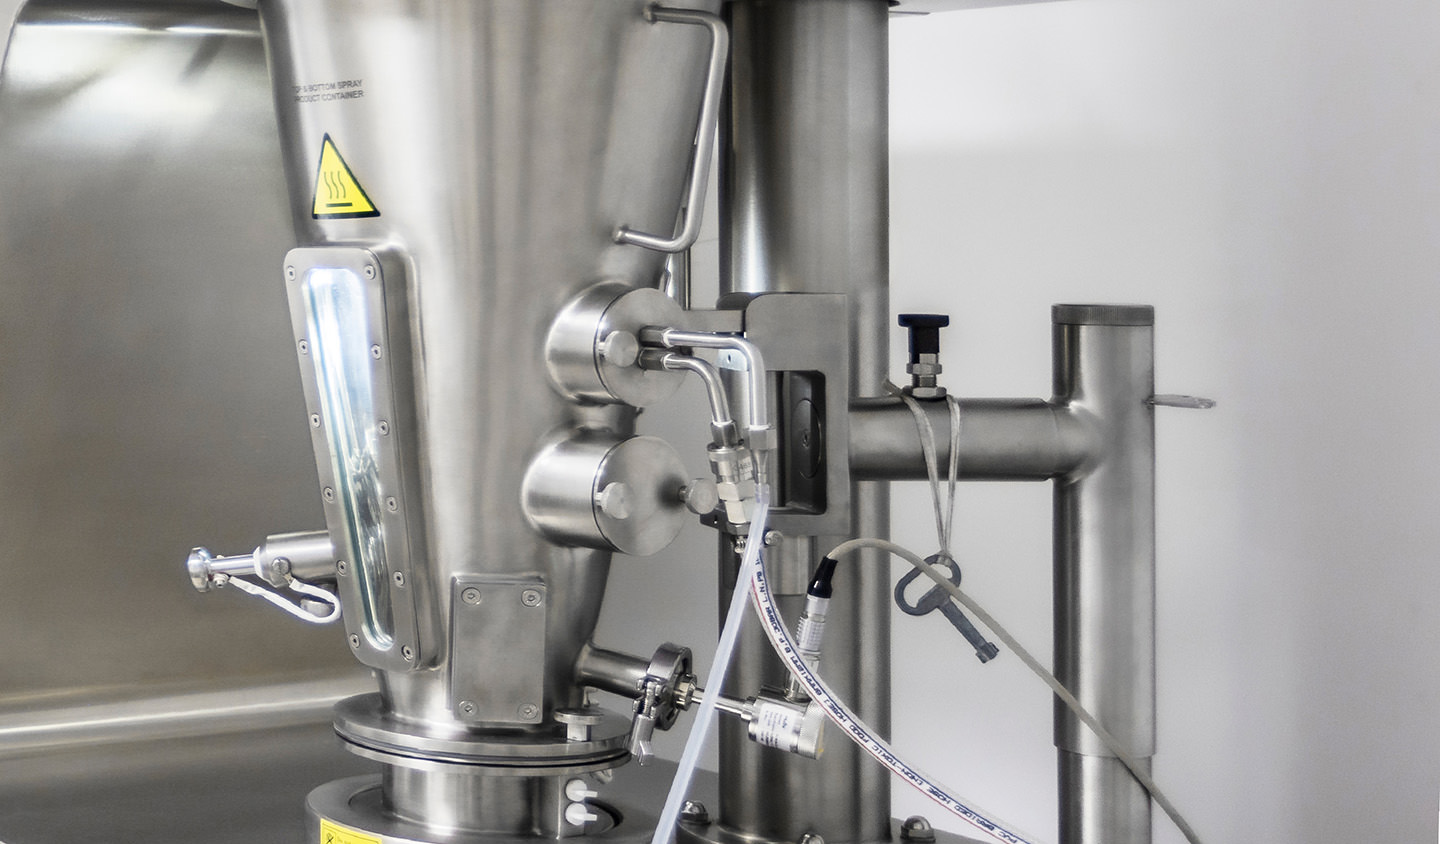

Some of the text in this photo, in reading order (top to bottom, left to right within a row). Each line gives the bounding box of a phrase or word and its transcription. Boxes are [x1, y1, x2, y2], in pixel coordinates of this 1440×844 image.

[308, 83, 335, 91] BOTTOM
[337, 80, 362, 89] SPRAY
[321, 90, 364, 101] CONTAINER
[849, 724, 869, 743] FOOD
[926, 786, 951, 804] HOSE
[954, 804, 995, 831] BRAIDED
[998, 831, 1018, 844] PVC
